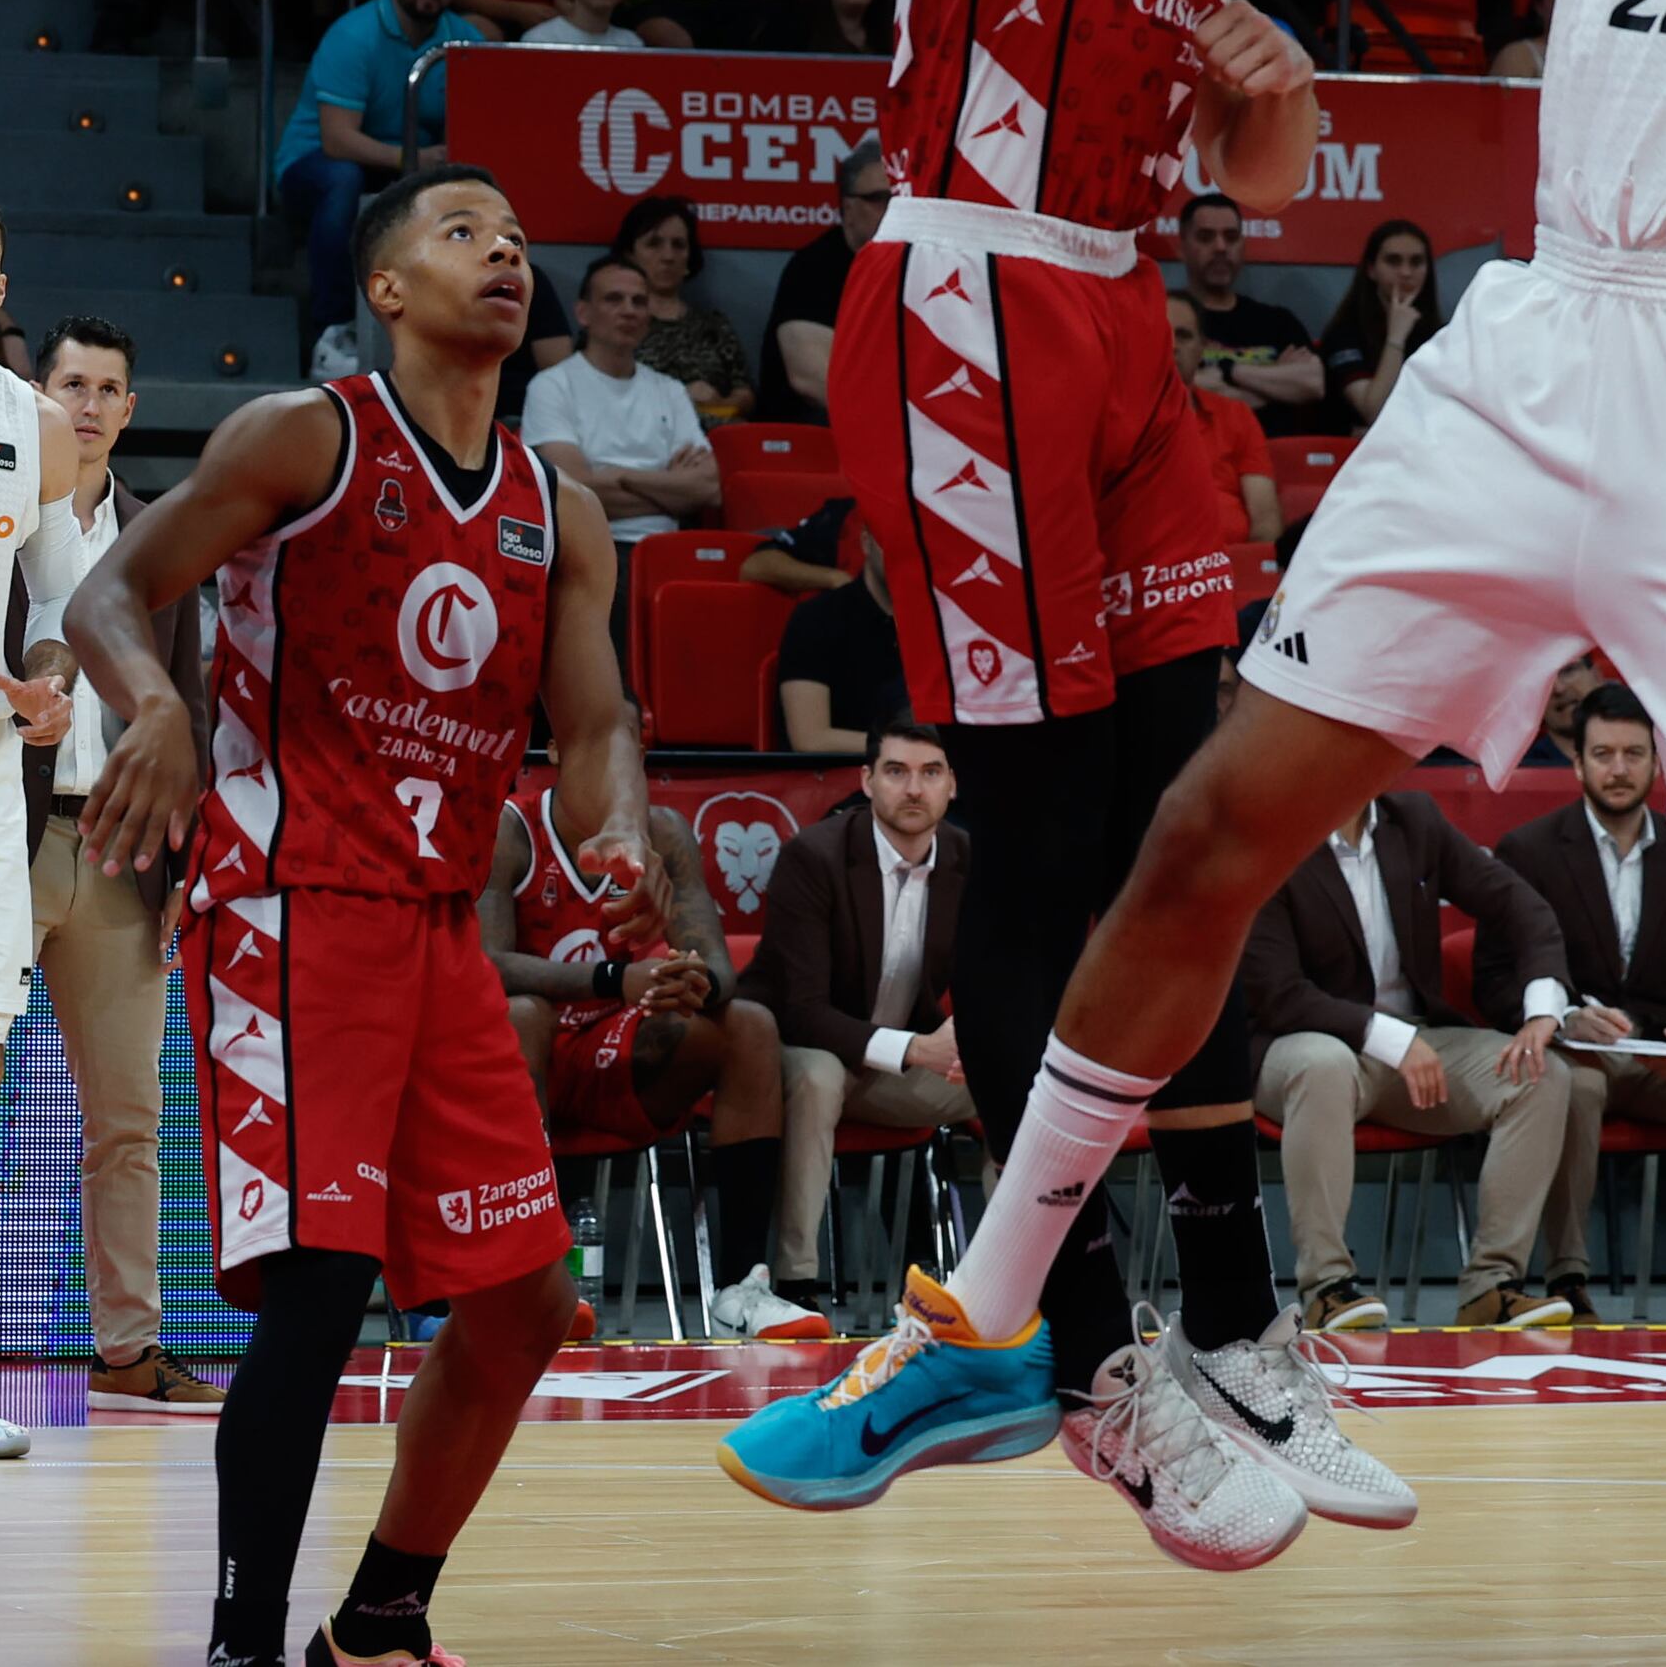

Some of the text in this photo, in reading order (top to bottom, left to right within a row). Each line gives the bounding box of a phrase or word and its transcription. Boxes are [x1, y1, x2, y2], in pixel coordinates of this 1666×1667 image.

[680, 90, 879, 125] BOMBAS
[476, 1167, 552, 1206] Zaragoza
[478, 1190, 556, 1232] DEPORTE
